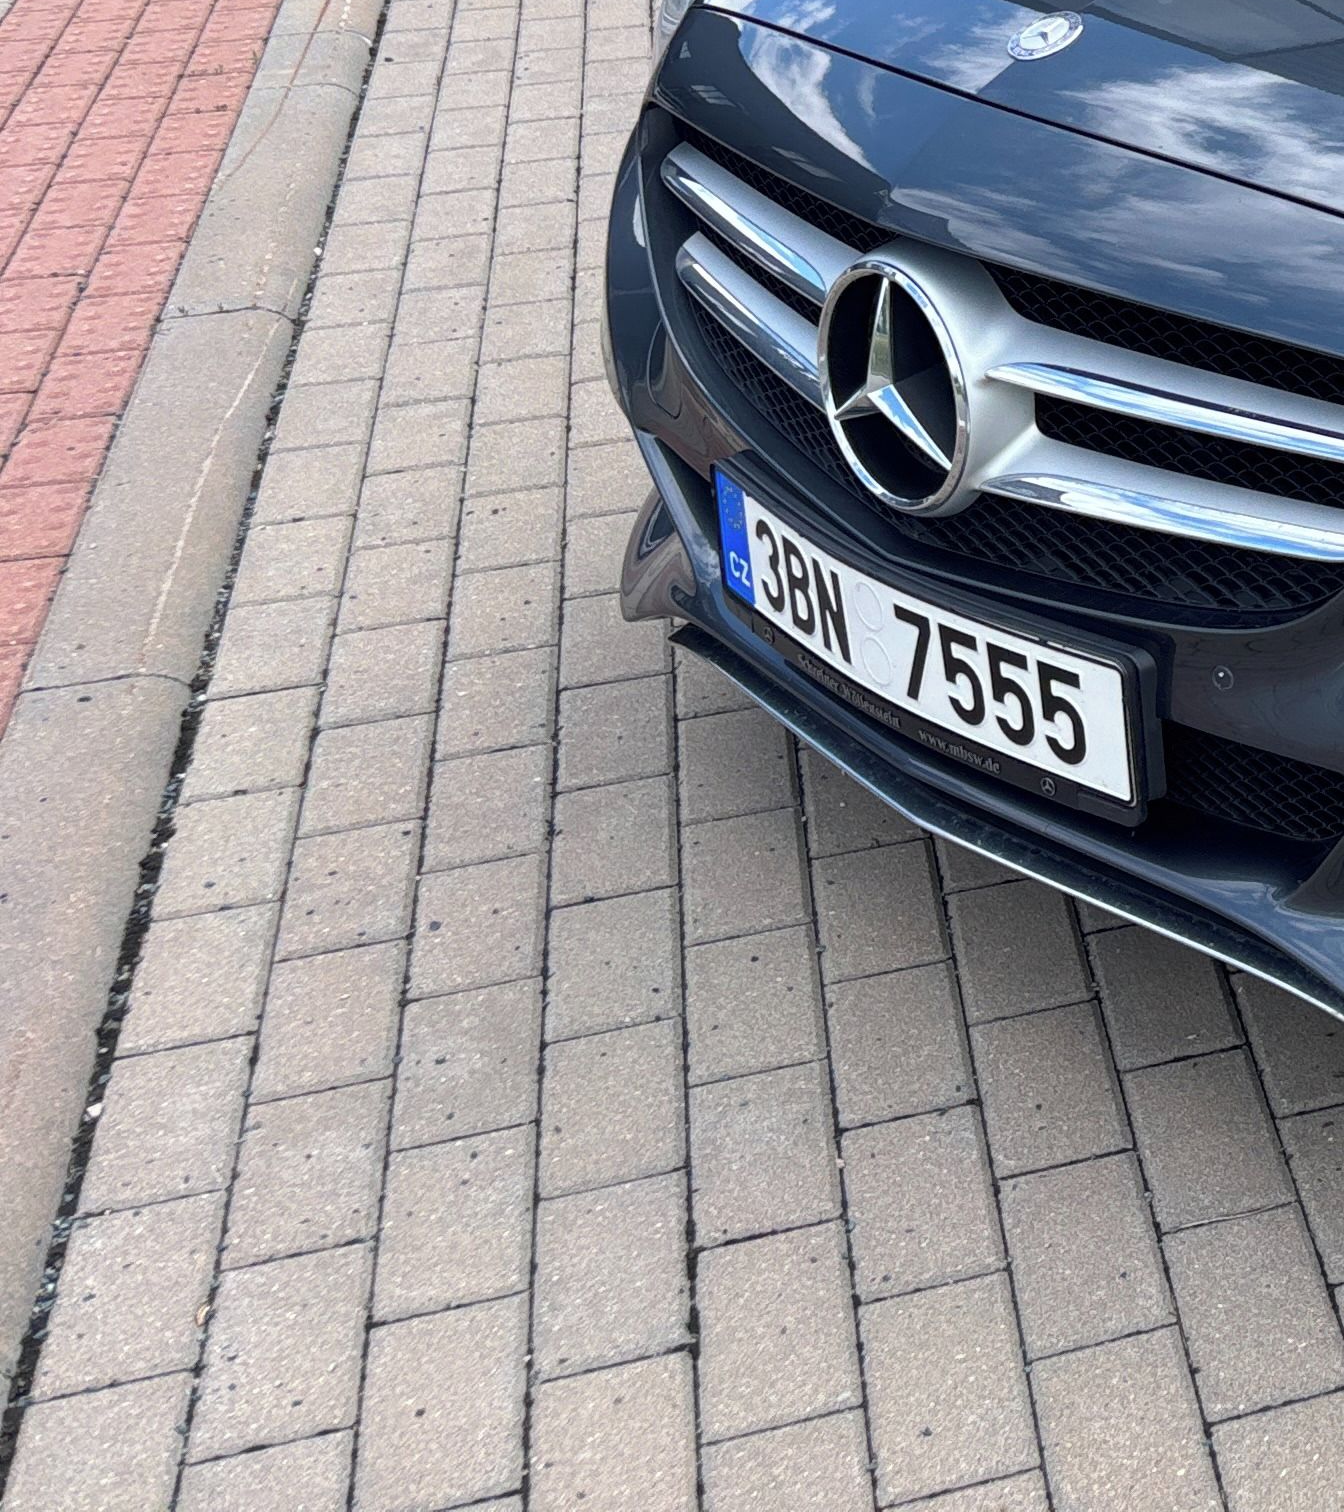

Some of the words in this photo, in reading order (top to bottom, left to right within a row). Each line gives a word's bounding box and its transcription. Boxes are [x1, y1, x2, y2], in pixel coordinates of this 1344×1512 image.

[728, 550, 752, 587] CZ
[756, 518, 853, 666] 3BN
[893, 602, 1087, 767] 7555
